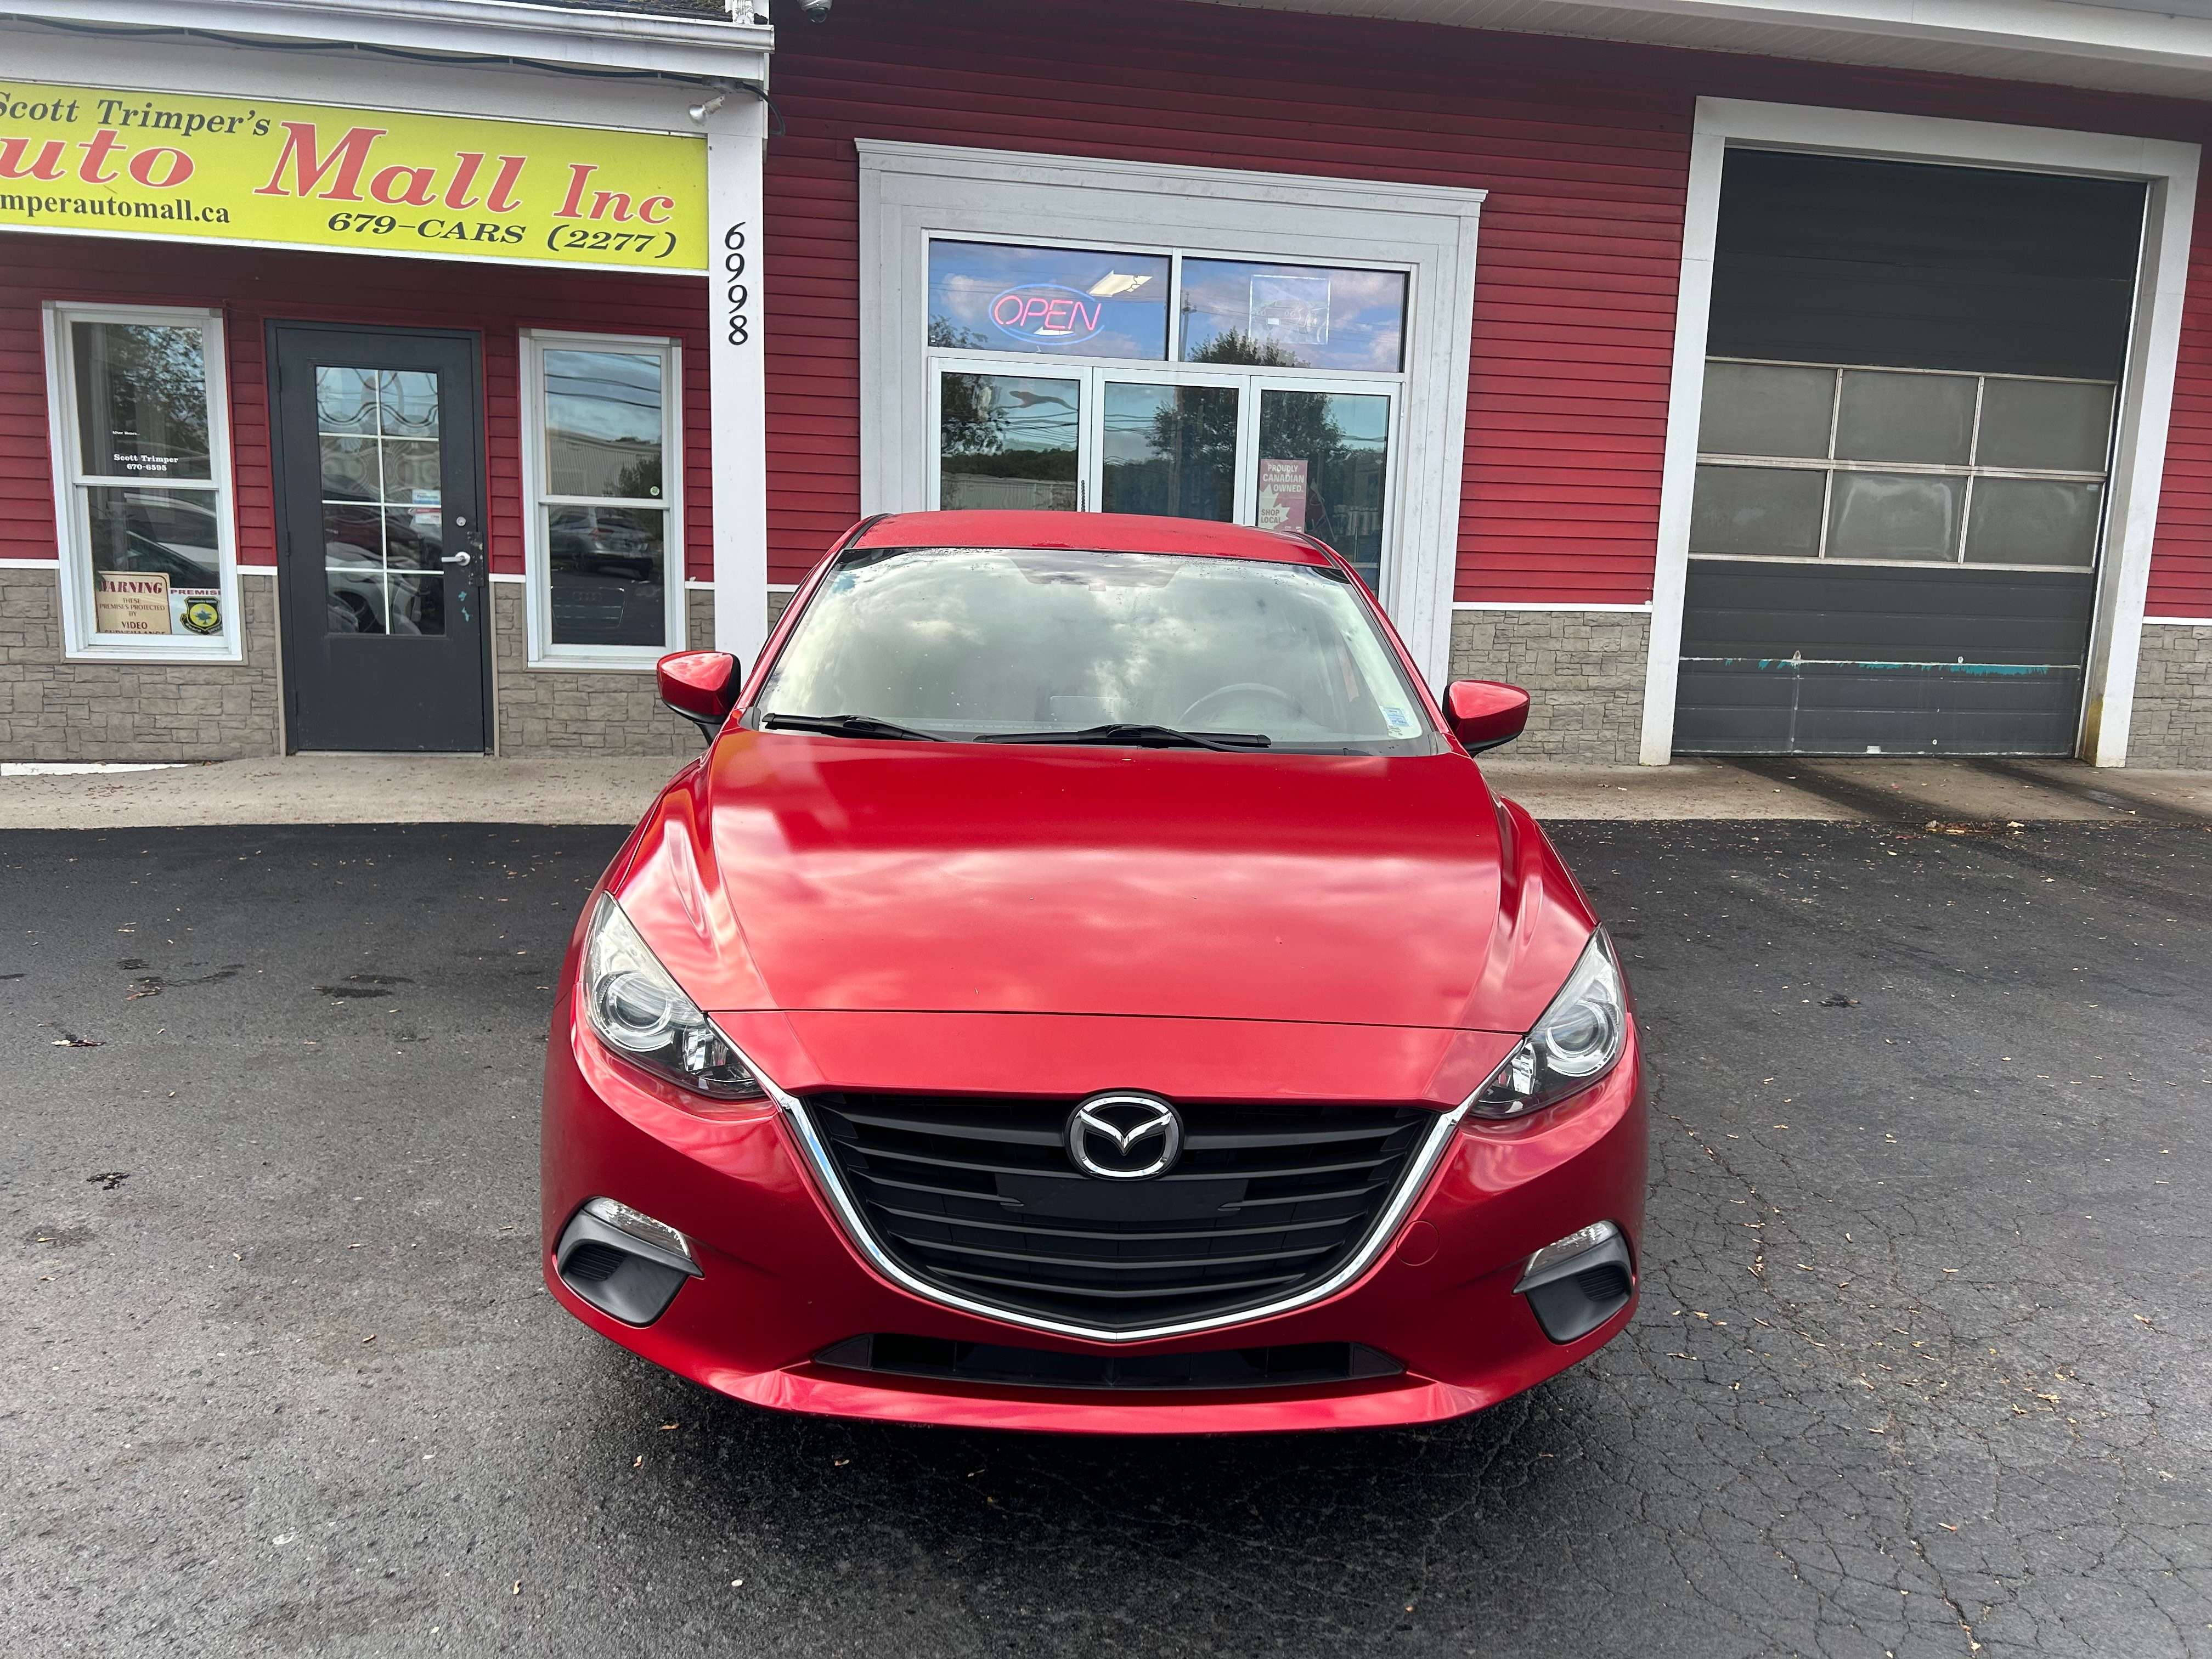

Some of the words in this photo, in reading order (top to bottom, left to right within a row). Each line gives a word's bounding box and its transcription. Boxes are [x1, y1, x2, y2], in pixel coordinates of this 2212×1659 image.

[0, 92, 80, 122] Scott
[98, 99, 271, 136] Trimper's
[0, 129, 195, 187] uto
[253, 121, 528, 214] Mall
[552, 163, 675, 224] Inc
[0, 194, 230, 223] mperautomall.ca
[329, 212, 527, 244] 679-CARS
[547, 223, 677, 258] (2277)
[724, 222, 748, 346] 6998
[994, 295, 1101, 330] OPEN
[140, 455, 178, 464] Trimper
[1268, 464, 1299, 472] PROUDLY
[1263, 473, 1304, 483] CANADIAN
[121, 621, 148, 629] VIDEO
